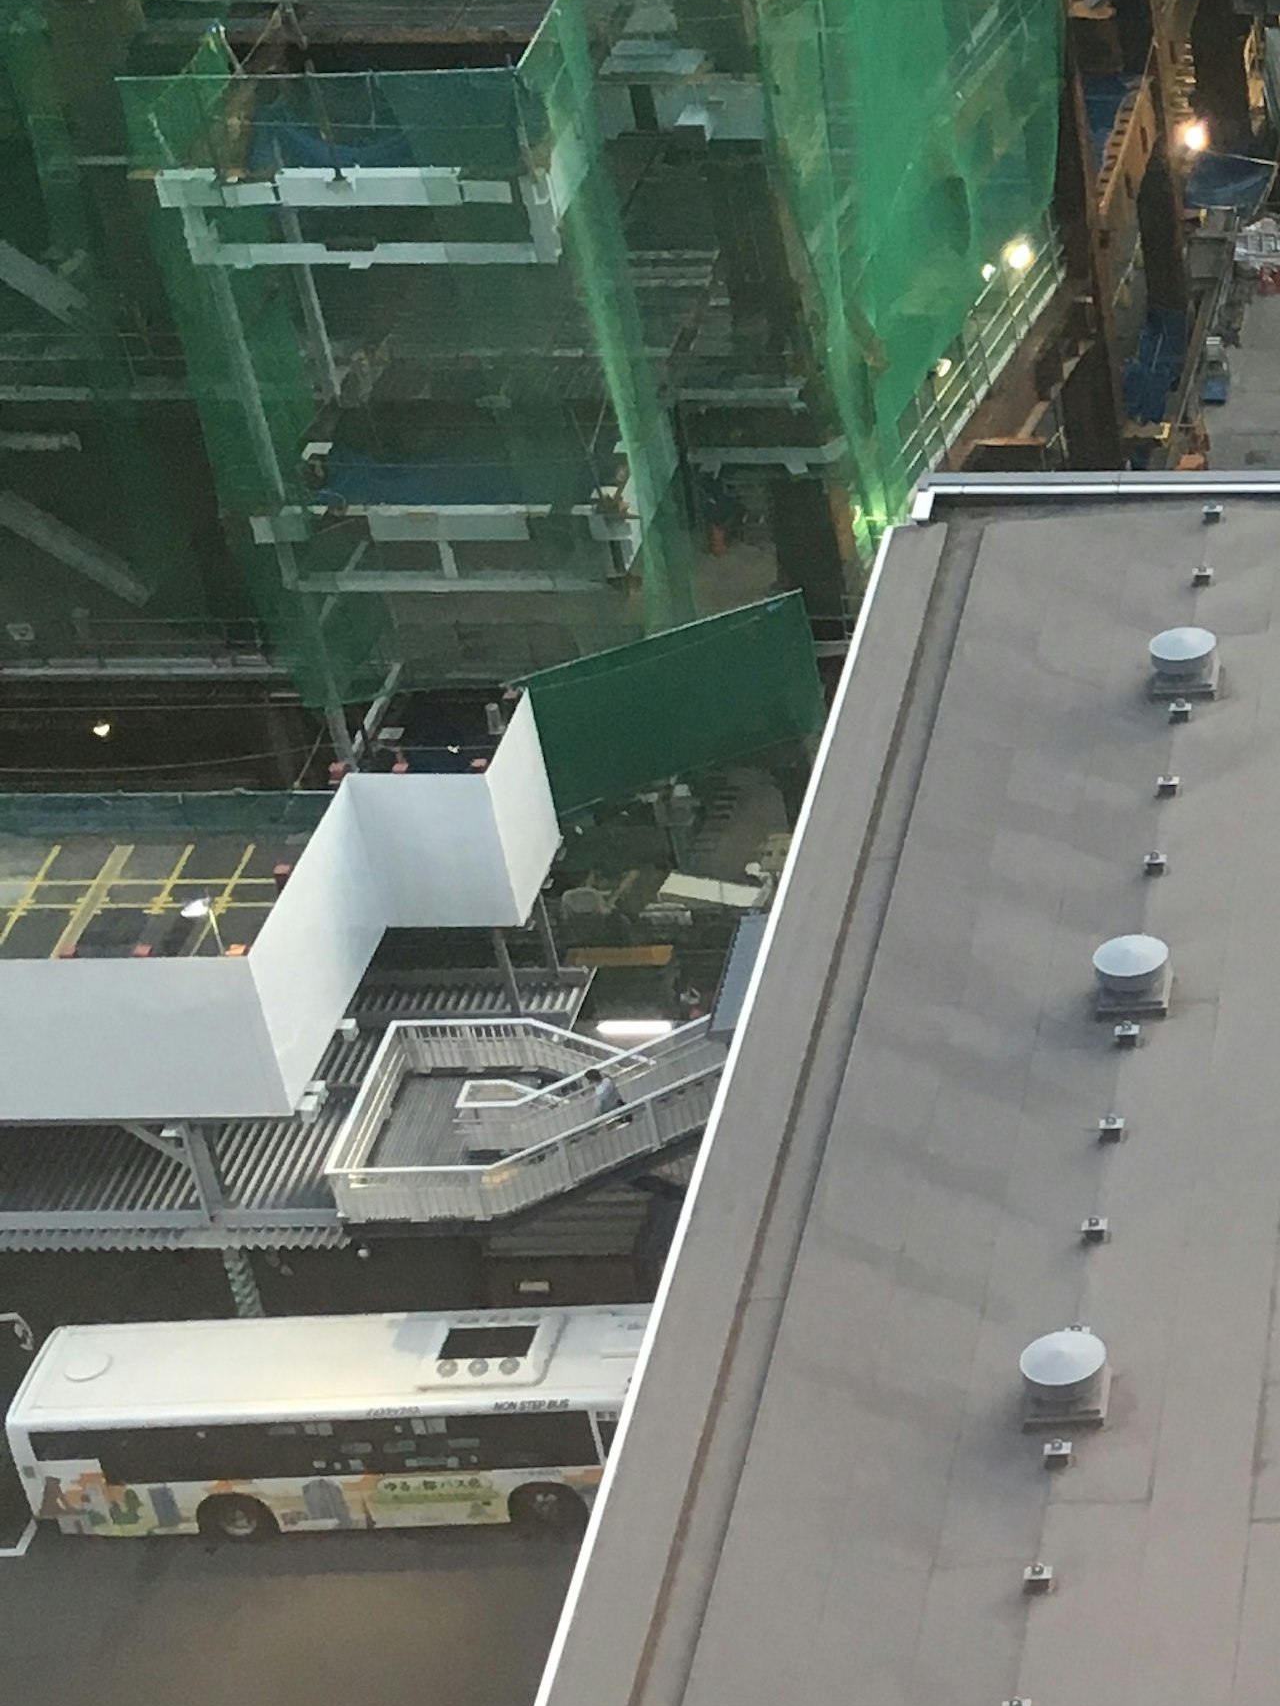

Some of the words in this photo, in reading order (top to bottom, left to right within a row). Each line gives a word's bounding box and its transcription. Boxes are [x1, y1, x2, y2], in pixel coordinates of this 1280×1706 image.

[494, 1402, 517, 1412] NON
[519, 1400, 546, 1411] STEP
[547, 1398, 570, 1410] BUS
